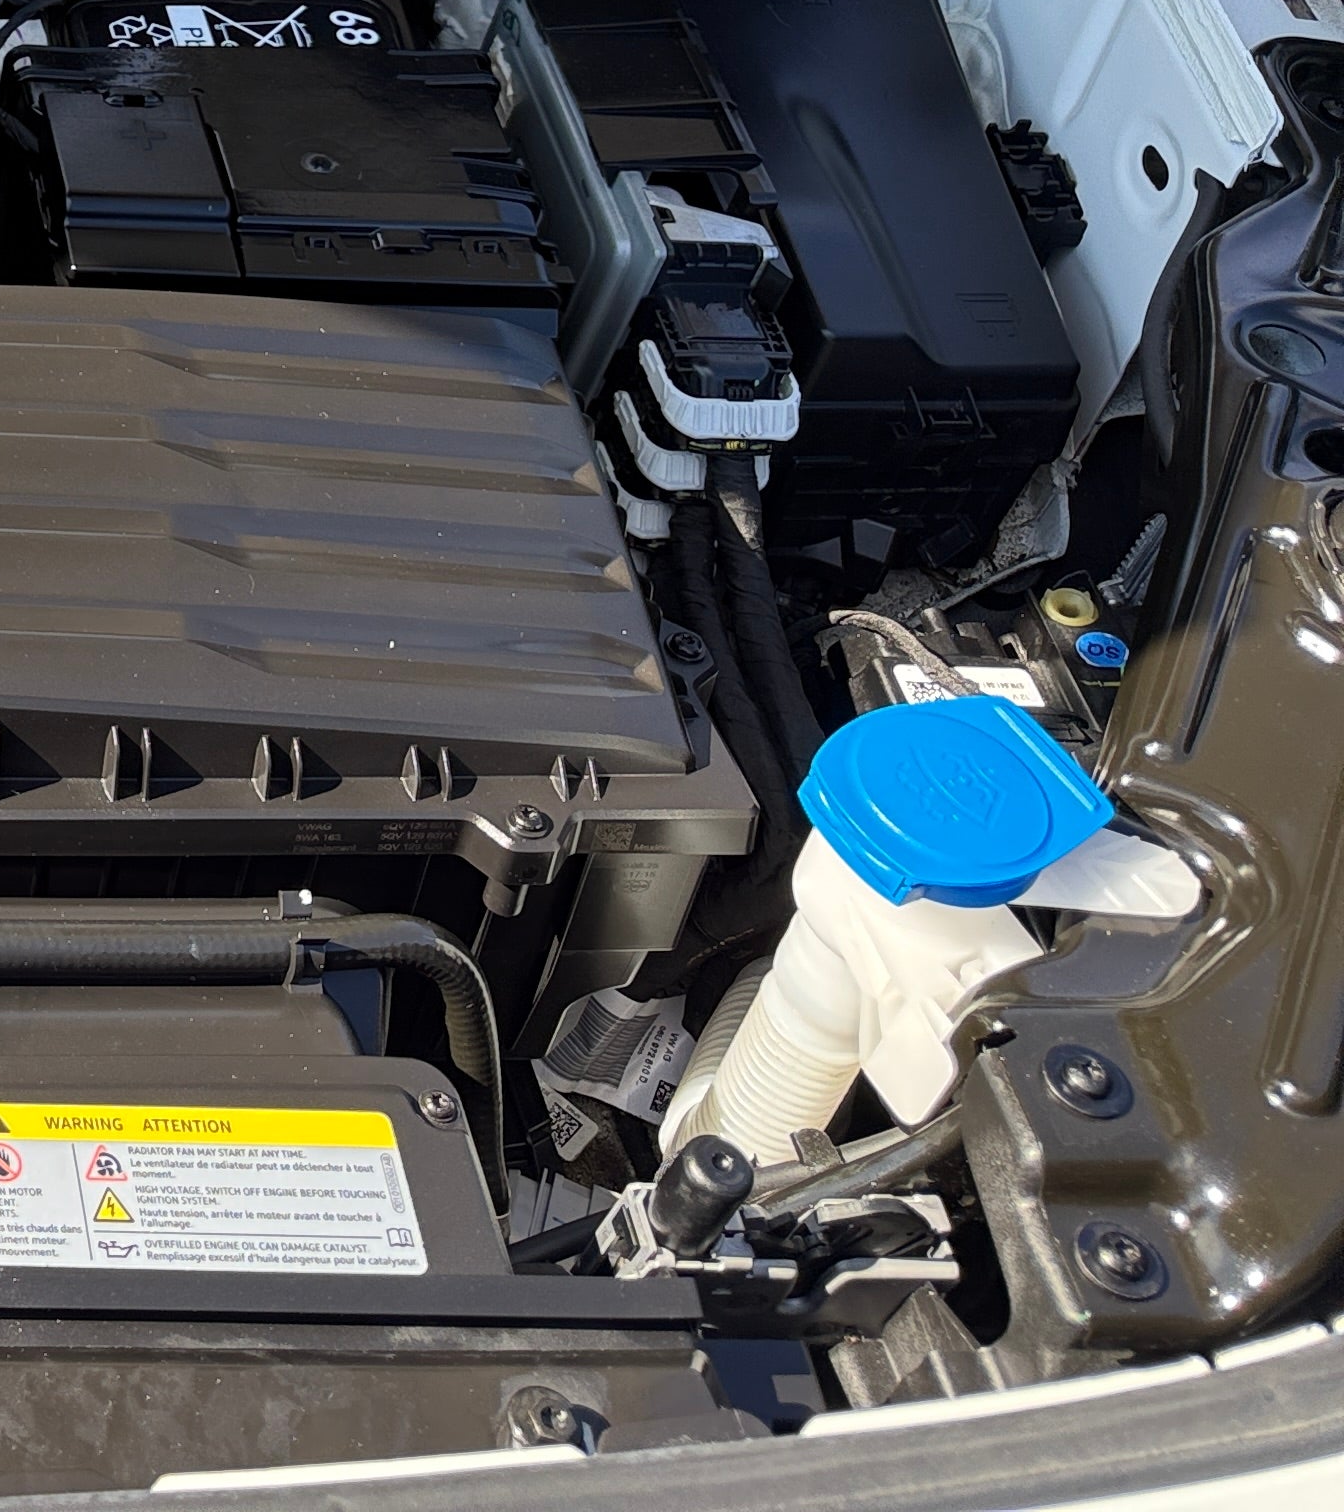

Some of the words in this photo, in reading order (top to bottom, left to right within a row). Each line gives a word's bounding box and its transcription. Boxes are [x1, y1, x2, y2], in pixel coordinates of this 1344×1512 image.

[1087, 641, 1120, 660] SQ
[43, 1115, 124, 1132] WARNING
[142, 1118, 233, 1134] ATTENTION
[128, 1146, 174, 1156] RADIATOR
[177, 1148, 194, 1156] FAN
[197, 1148, 216, 1156] MAY
[219, 1148, 245, 1157] START
[248, 1149, 258, 1157] AT
[261, 1149, 280, 1158] ANY
[282, 1150, 307, 1159] TIME.
[130, 1158, 141, 1167] Le
[144, 1159, 194, 1168] ventilateur
[197, 1160, 208, 1169] de
[211, 1161, 253, 1170] radiateur
[256, 1162, 277, 1171] peut
[293, 1162, 343, 1172] déclencher
[354, 1164, 373, 1172] tout
[132, 1170, 176, 1178] moment.
[8, 1188, 42, 1196] MOTOR
[135, 1185, 158, 1194] HIGH
[205, 1186, 241, 1195] SWITCH
[243, 1187, 260, 1196] OFF
[263, 1188, 297, 1197] ENGINE
[300, 1189, 336, 1198] BEFORE
[338, 1190, 386, 1199] TOUCHING
[137, 1196, 179, 1204] IGNITION
[181, 1197, 220, 1205] SYSTEM.
[139, 1208, 168, 1217] Haute
[170, 1209, 208, 1219] tension,
[211, 1209, 243, 1219] arrêter
[246, 1210, 254, 1218] le
[257, 1211, 291, 1220] moteur
[323, 1212, 335, 1221] de
[337, 1213, 373, 1222] toucher
[7, 1223, 24, 1232] très
[26, 1224, 58, 1233] chauds
[61, 1224, 82, 1233] dans
[144, 1240, 202, 1249] OVERFILLED
[204, 1241, 239, 1250] ENGINE
[242, 1242, 257, 1250] OIL
[259, 1242, 279, 1250] CAN
[282, 1242, 320, 1251] DAMAGE
[323, 1243, 371, 1253] CATALYST.
[147, 1251, 206, 1262] Remplissage
[209, 1253, 245, 1261] excessif
[248, 1253, 279, 1263] d'huile
[282, 1254, 331, 1266] dangereux
[334, 1256, 355, 1266] pour
[357, 1255, 366, 1264] le
